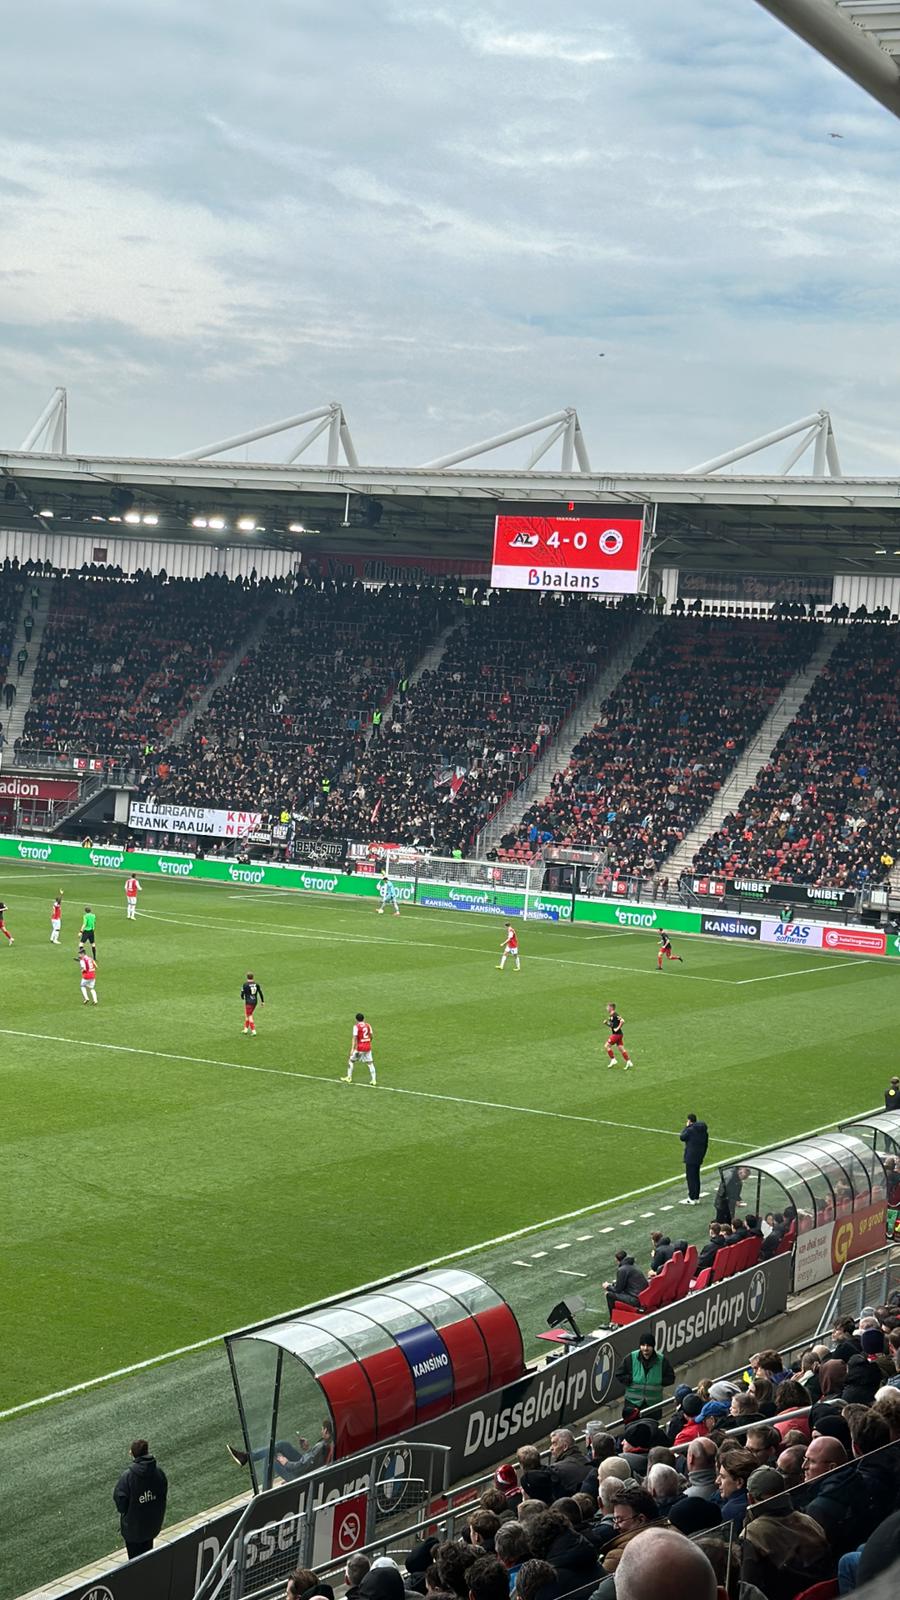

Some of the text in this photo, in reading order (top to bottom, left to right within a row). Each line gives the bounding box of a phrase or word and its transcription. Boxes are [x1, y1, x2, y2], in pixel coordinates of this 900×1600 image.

[542, 571, 600, 588] balans
[132, 803, 204, 819] TELOORGANG
[129, 816, 168, 829] FRANK
[173, 820, 214, 833] PAAUW
[734, 881, 771, 894] UNIBET
[807, 889, 845, 901] UNIBET
[774, 924, 810, 937] AFAS
[776, 935, 806, 944] software
[363, 1027, 369, 1038] 2
[654, 1291, 745, 1354] Dusseldorp
[412, 1352, 448, 1378] KANSINO
[464, 1368, 587, 1457] Dusseldorp
